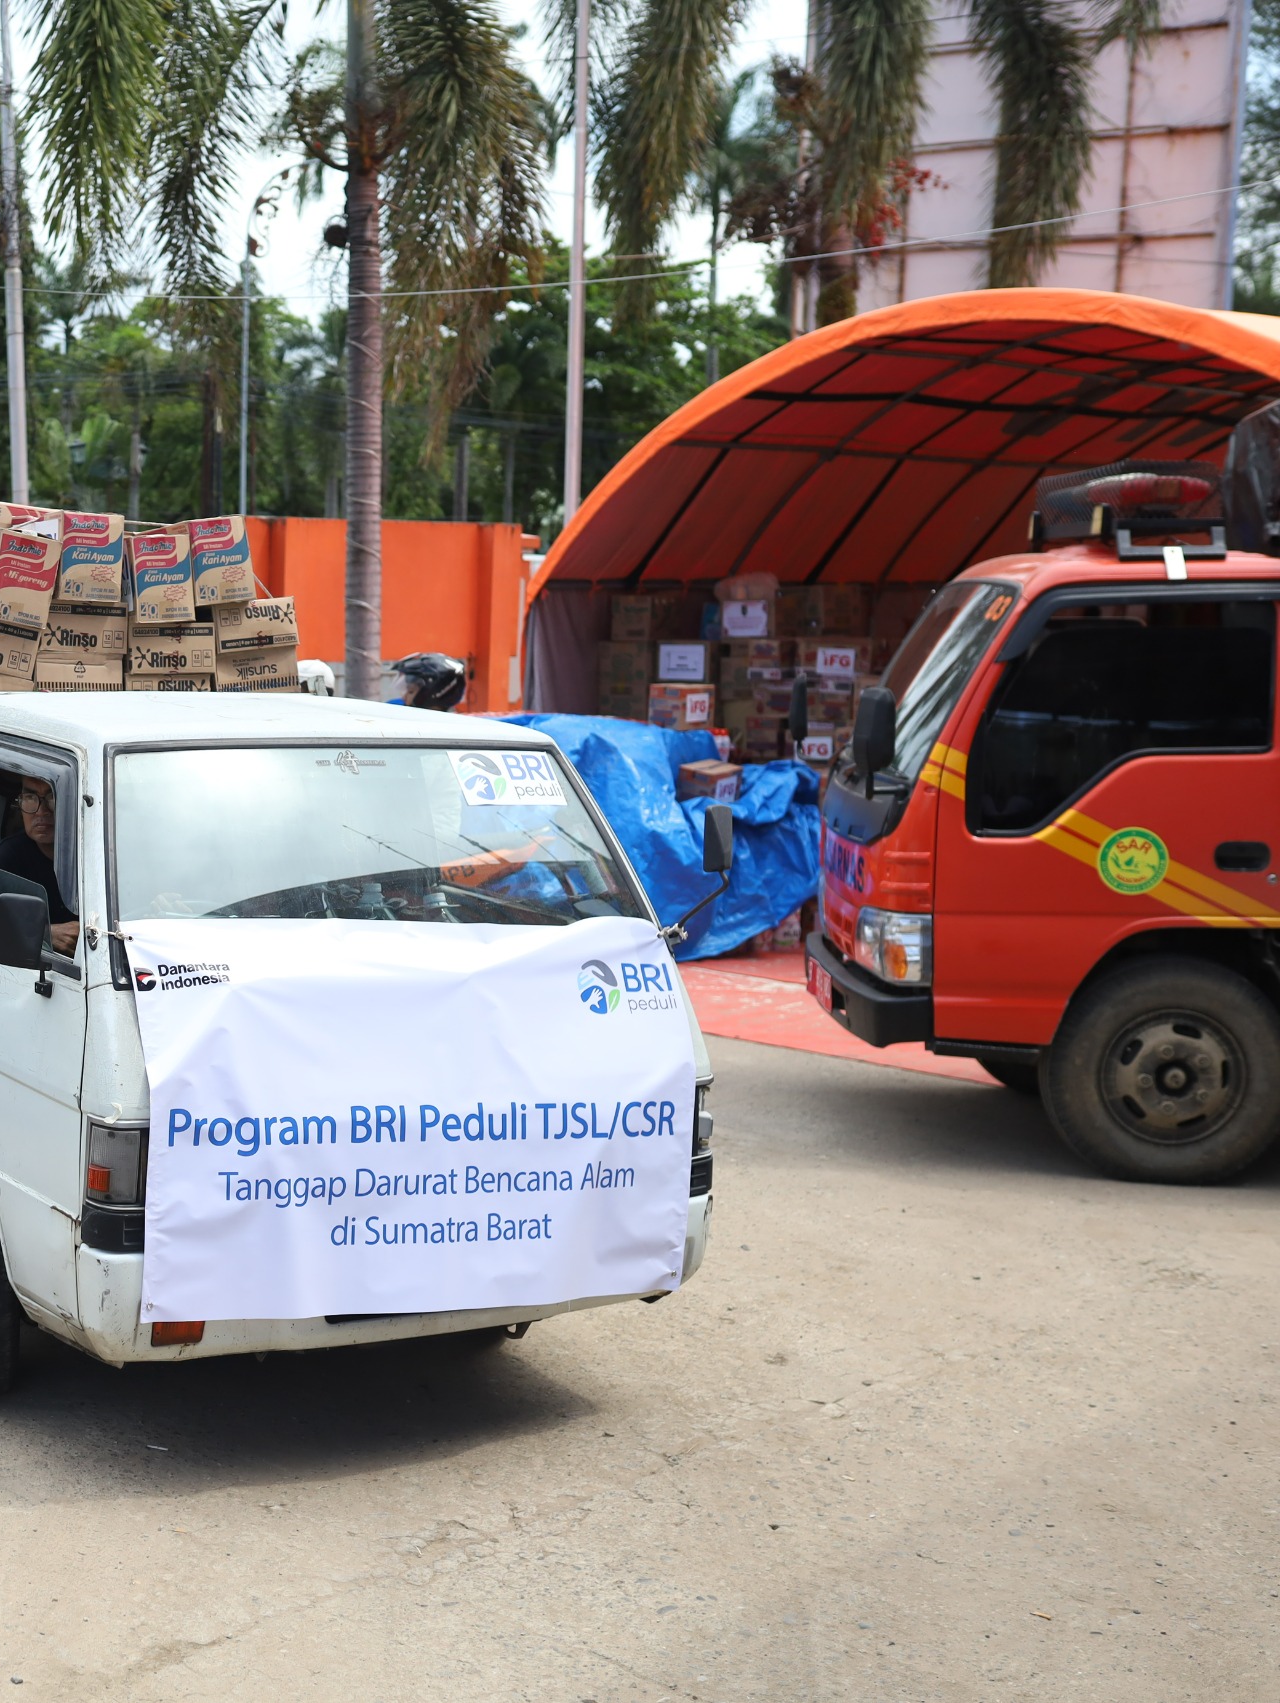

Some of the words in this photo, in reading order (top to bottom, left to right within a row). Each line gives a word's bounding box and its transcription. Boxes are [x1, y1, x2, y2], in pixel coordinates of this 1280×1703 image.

[72, 550, 91, 560] Kari
[91, 553, 114, 563] Ayam
[202, 556, 219, 566] Kari
[220, 555, 242, 566] Ayam
[18, 575, 48, 588] goreng
[144, 573, 162, 583] Kari
[162, 573, 184, 584] Ayam
[245, 605, 280, 621] Rinso
[60, 629, 98, 648] Rinso
[151, 650, 187, 668] Rinso
[236, 663, 277, 680] sunsilk
[500, 753, 556, 782] BRI
[513, 781, 561, 800] peduli
[1116, 838, 1152, 855] SAR
[157, 962, 230, 977] Danantara
[620, 962, 673, 992] BRI
[160, 972, 230, 991] Indonesia
[627, 994, 678, 1014] peduli
[168, 1108, 337, 1157] Program
[350, 1105, 406, 1144] BRI
[419, 1102, 527, 1142] Peduli
[535, 1100, 676, 1140] TJSL/CSR
[217, 1171, 347, 1208] Tanggap
[354, 1167, 458, 1197] Darurat
[465, 1165, 573, 1194] Bencana
[580, 1161, 635, 1190] Alam
[330, 1216, 356, 1246] di
[365, 1215, 478, 1246] Sumatra
[487, 1212, 552, 1241] Barat
